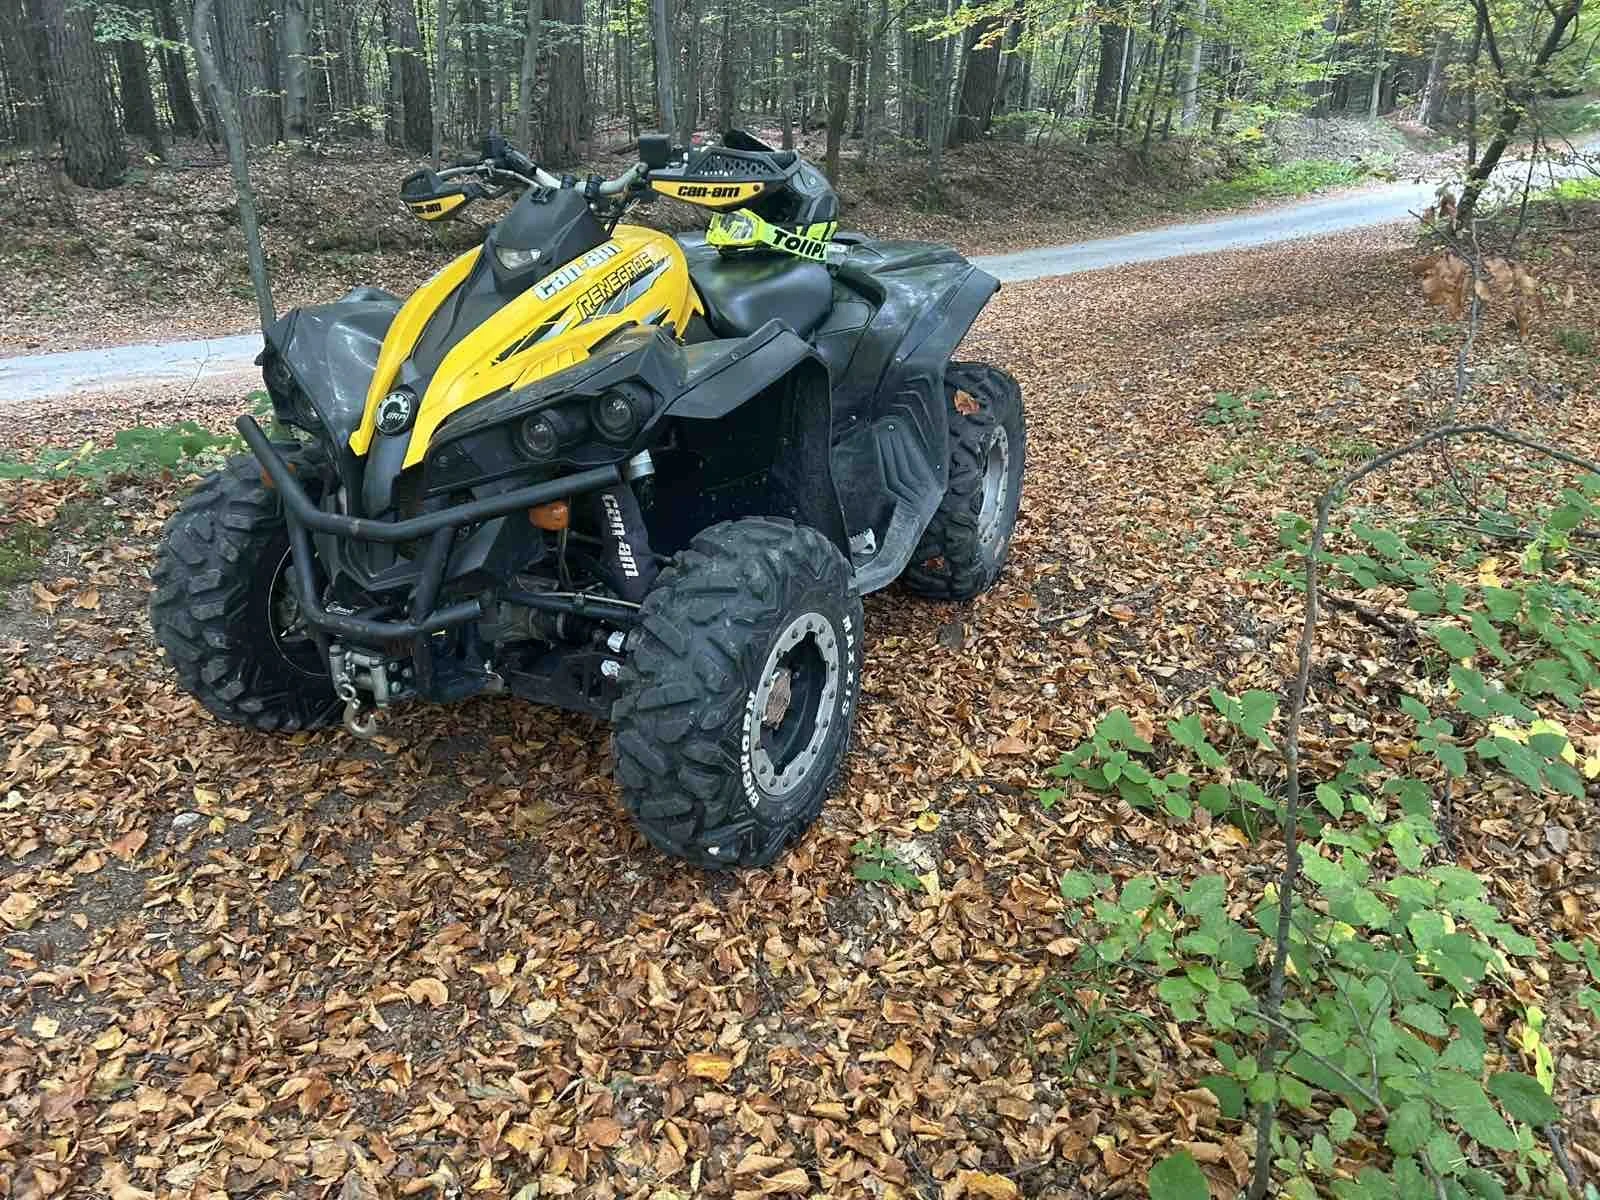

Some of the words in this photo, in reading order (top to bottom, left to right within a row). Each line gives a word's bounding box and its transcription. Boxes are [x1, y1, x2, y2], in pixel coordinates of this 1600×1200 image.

[678, 184, 740, 199] can-am
[533, 241, 623, 301] can-am
[575, 251, 656, 321] RENEGADE
[385, 411, 406, 423] BRP
[601, 494, 639, 577] can-am
[841, 615, 855, 716] MAXXIS
[740, 690, 760, 809] BIGHORN
